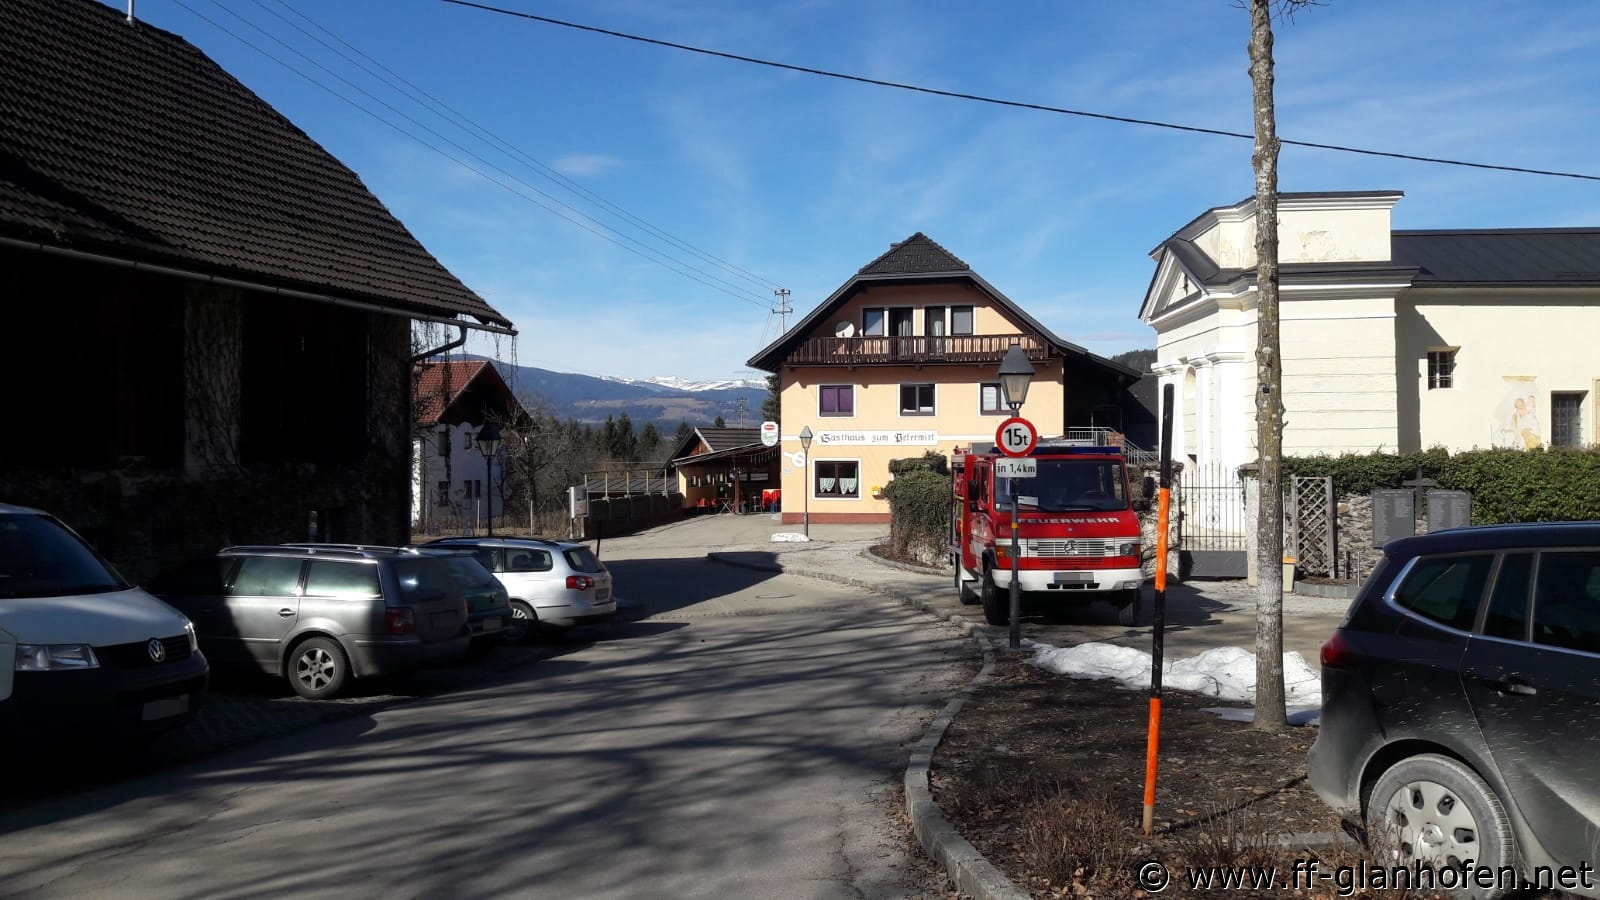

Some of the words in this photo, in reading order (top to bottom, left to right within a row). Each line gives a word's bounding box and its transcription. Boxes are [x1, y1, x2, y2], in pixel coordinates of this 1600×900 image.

[871, 433, 889, 443] zum
[997, 462, 1007, 473] in
[1017, 517, 1121, 525] FEUERWEHR
